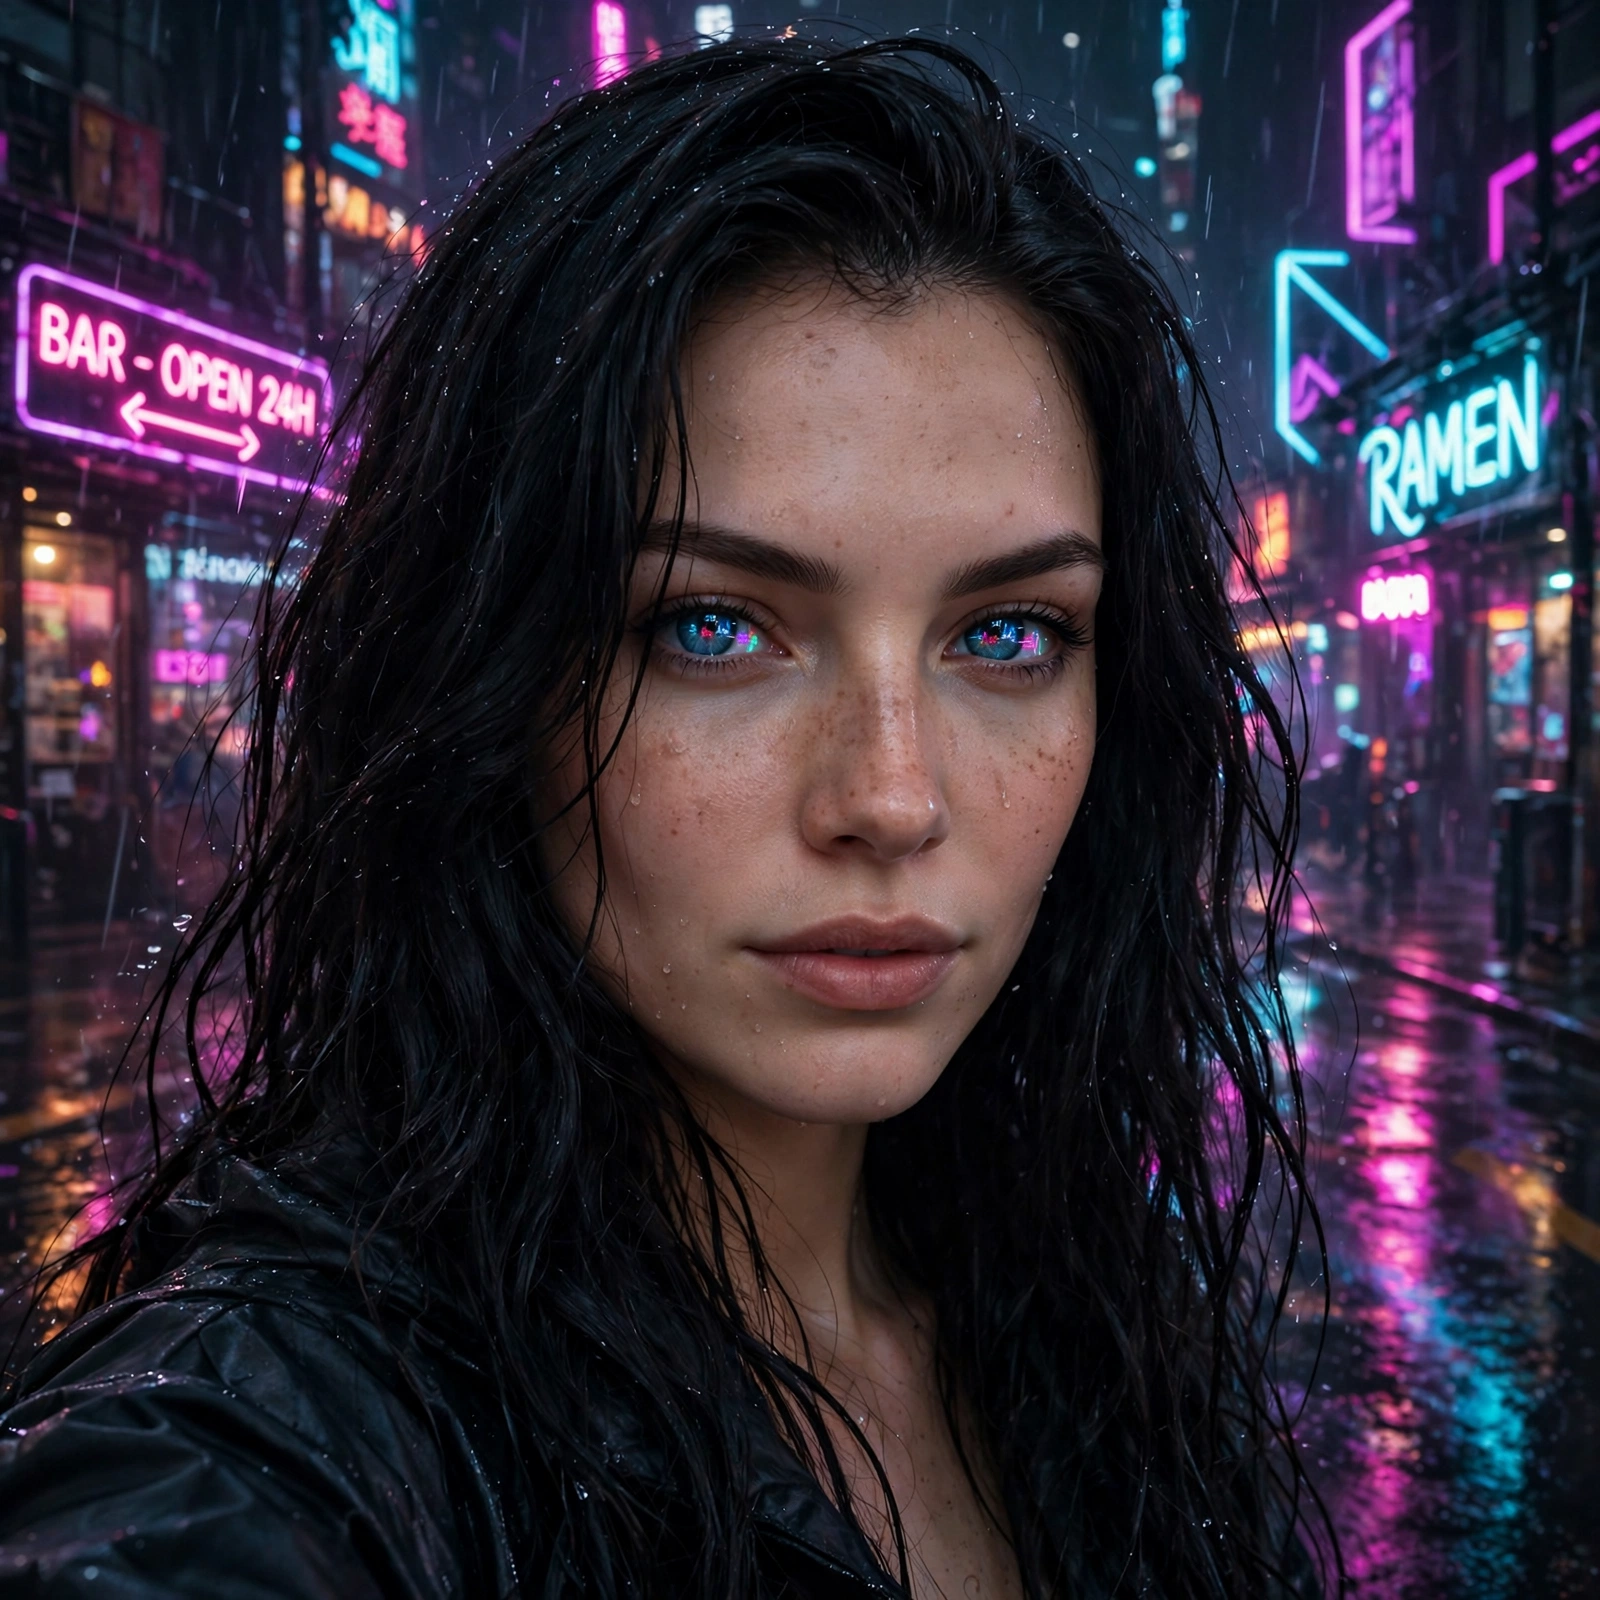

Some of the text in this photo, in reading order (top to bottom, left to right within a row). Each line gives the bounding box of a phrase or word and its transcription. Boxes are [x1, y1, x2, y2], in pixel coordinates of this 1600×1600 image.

[39, 302, 126, 383] BAR
[160, 343, 253, 417] OPEN
[257, 374, 316, 437] 24H
[1359, 355, 1538, 537] RAMEN
